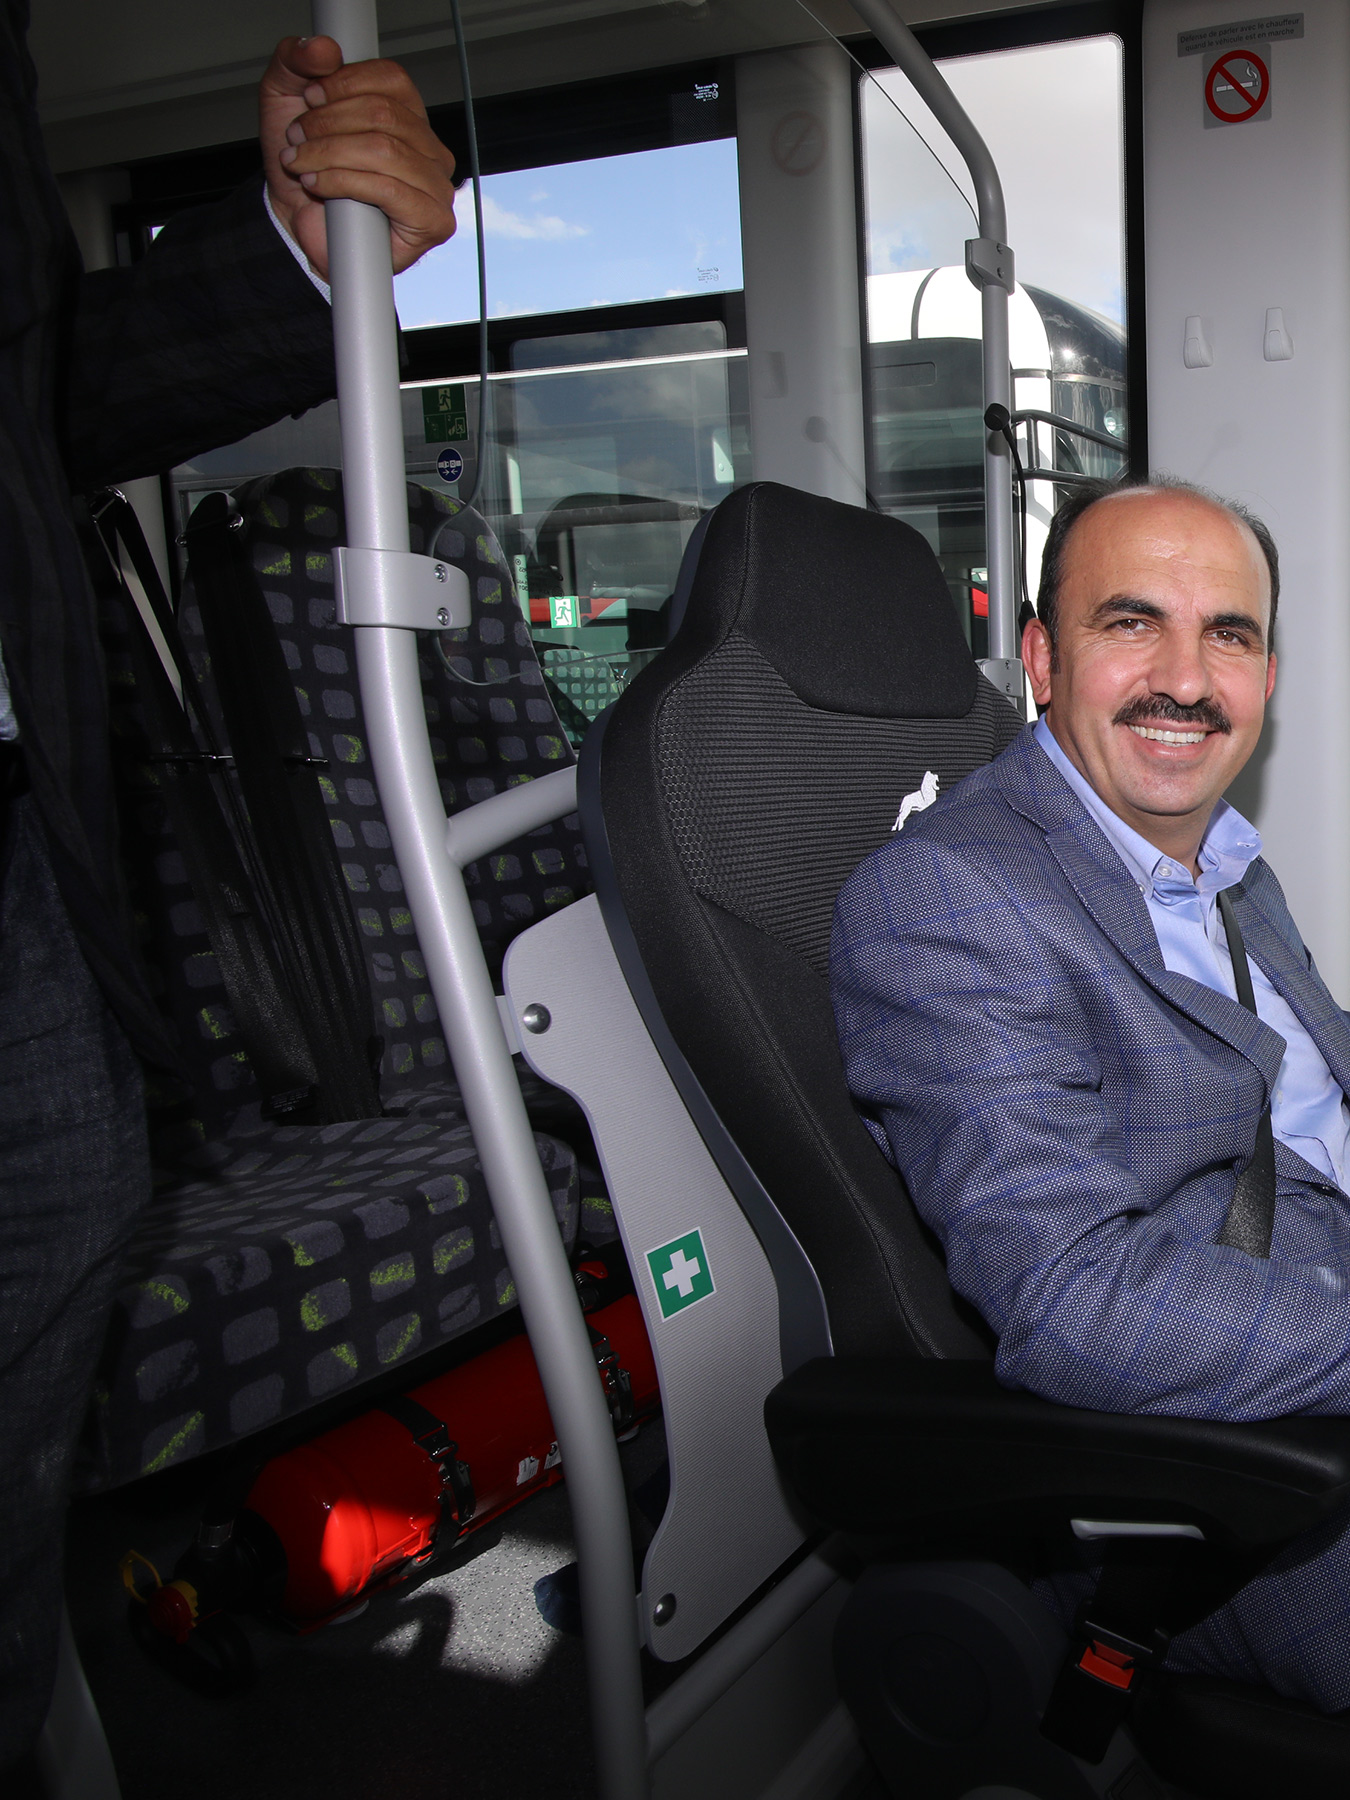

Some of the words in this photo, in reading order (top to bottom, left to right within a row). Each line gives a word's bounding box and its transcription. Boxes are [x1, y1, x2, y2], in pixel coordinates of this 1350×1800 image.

[1209, 29, 1218, 38] de
[1218, 27, 1238, 38] parler
[1239, 24, 1256, 32] avec
[1258, 22, 1264, 30] le
[1265, 18, 1300, 29] chauffeur
[1185, 41, 1207, 52] quand
[1207, 39, 1214, 47] le
[1245, 33, 1256, 41] est
[1268, 28, 1294, 37] marche
